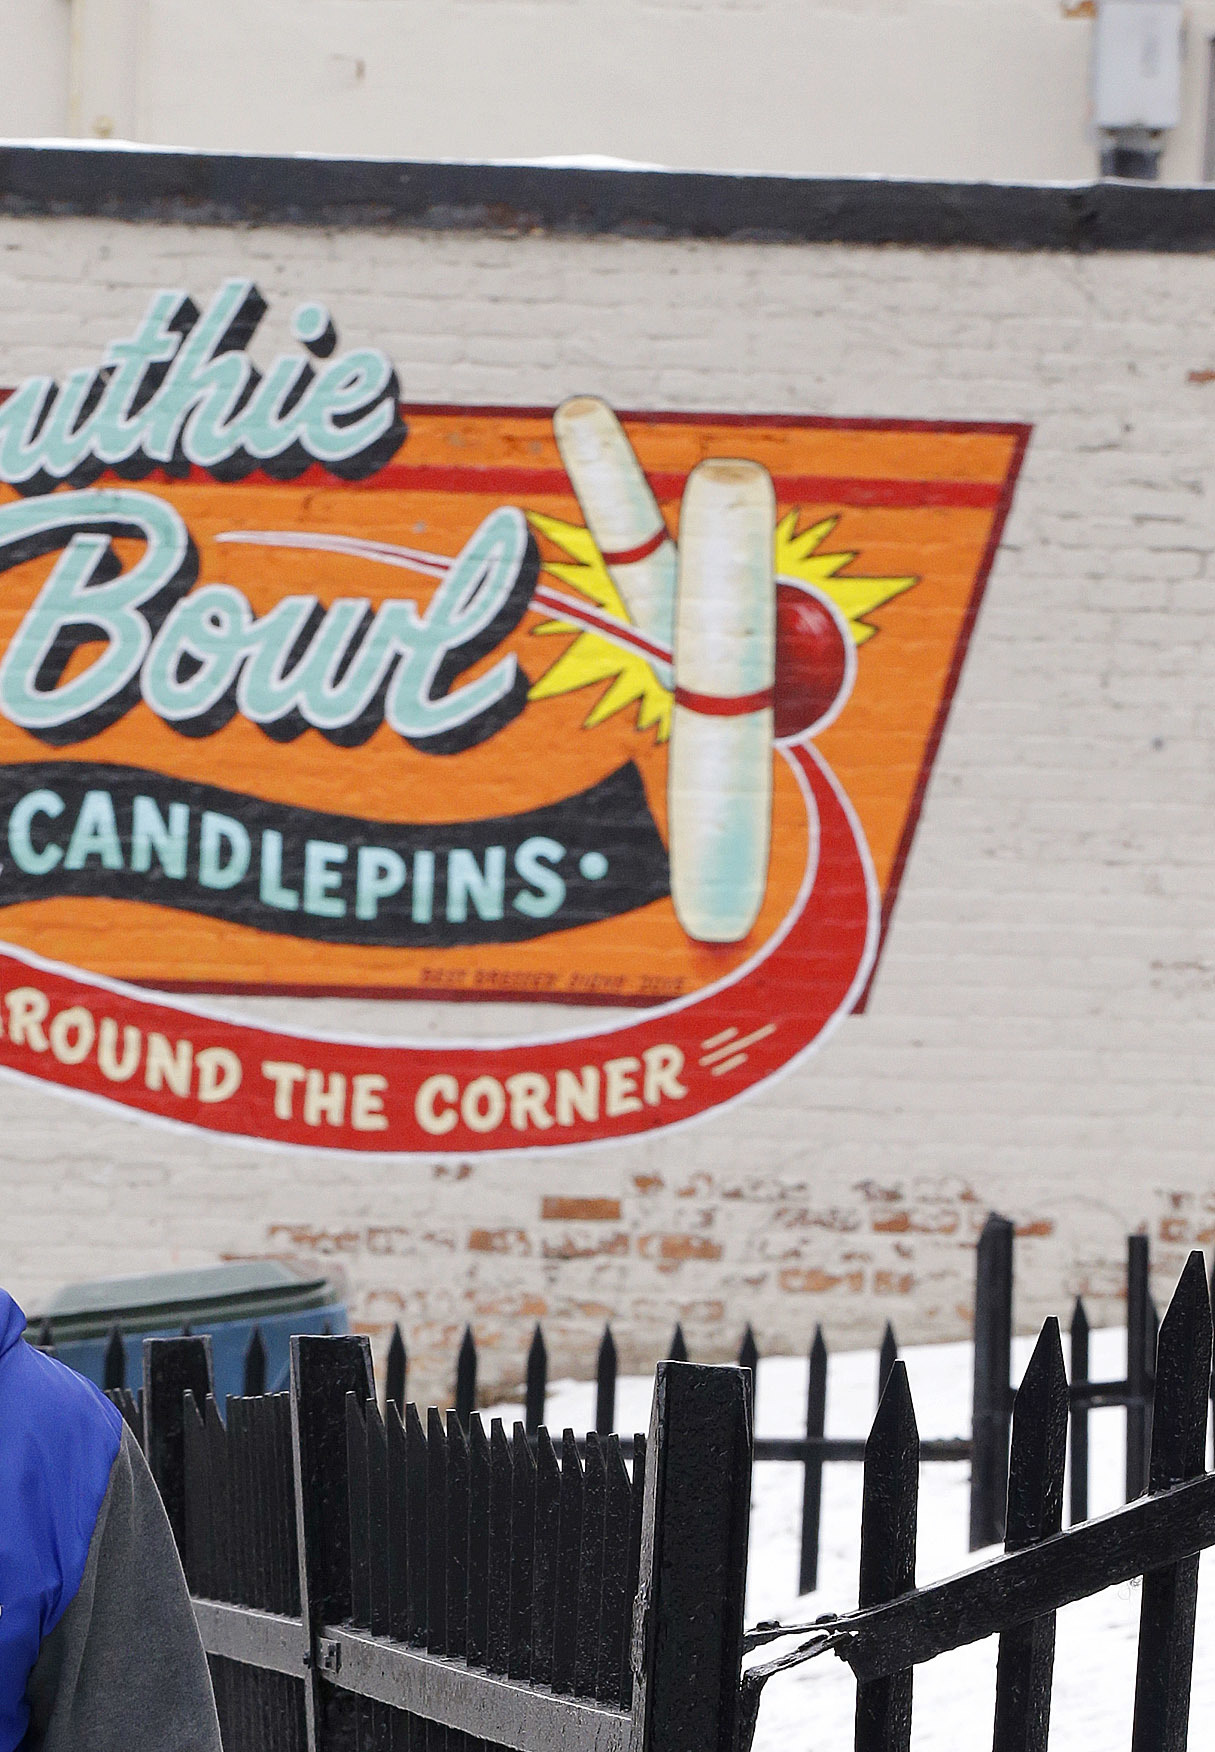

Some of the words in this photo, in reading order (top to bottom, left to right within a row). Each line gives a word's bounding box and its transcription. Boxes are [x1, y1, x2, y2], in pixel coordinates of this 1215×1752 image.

[7, 788, 567, 925] CANDLEPINS
[261, 1060, 389, 1132] THE
[414, 1043, 688, 1136] CORNER
